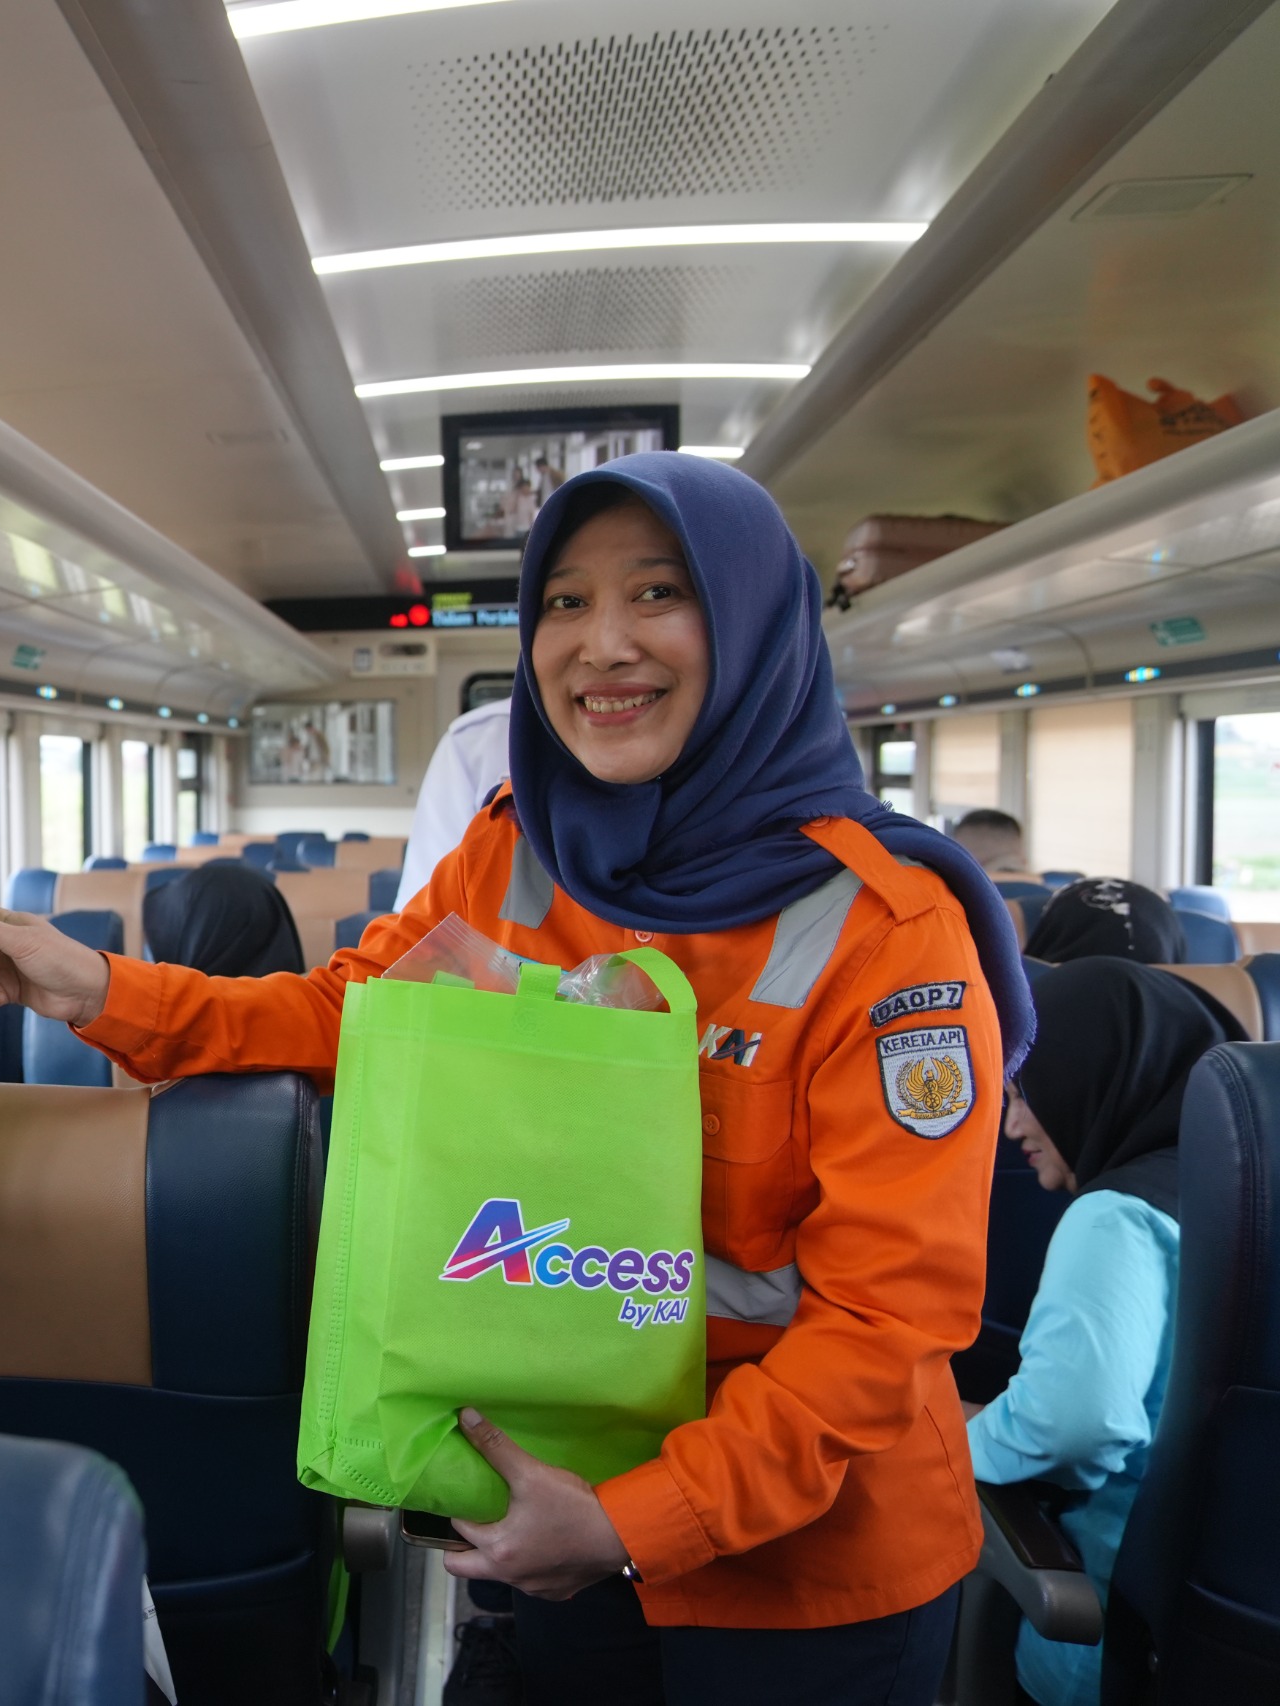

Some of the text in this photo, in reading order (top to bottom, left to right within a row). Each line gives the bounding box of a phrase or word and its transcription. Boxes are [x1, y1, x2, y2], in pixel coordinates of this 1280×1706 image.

[699, 1023, 762, 1067] KAI
[881, 1031, 962, 1054] KERETA API
[439, 1197, 694, 1295] Access
[618, 1296, 689, 1329] by KAI
